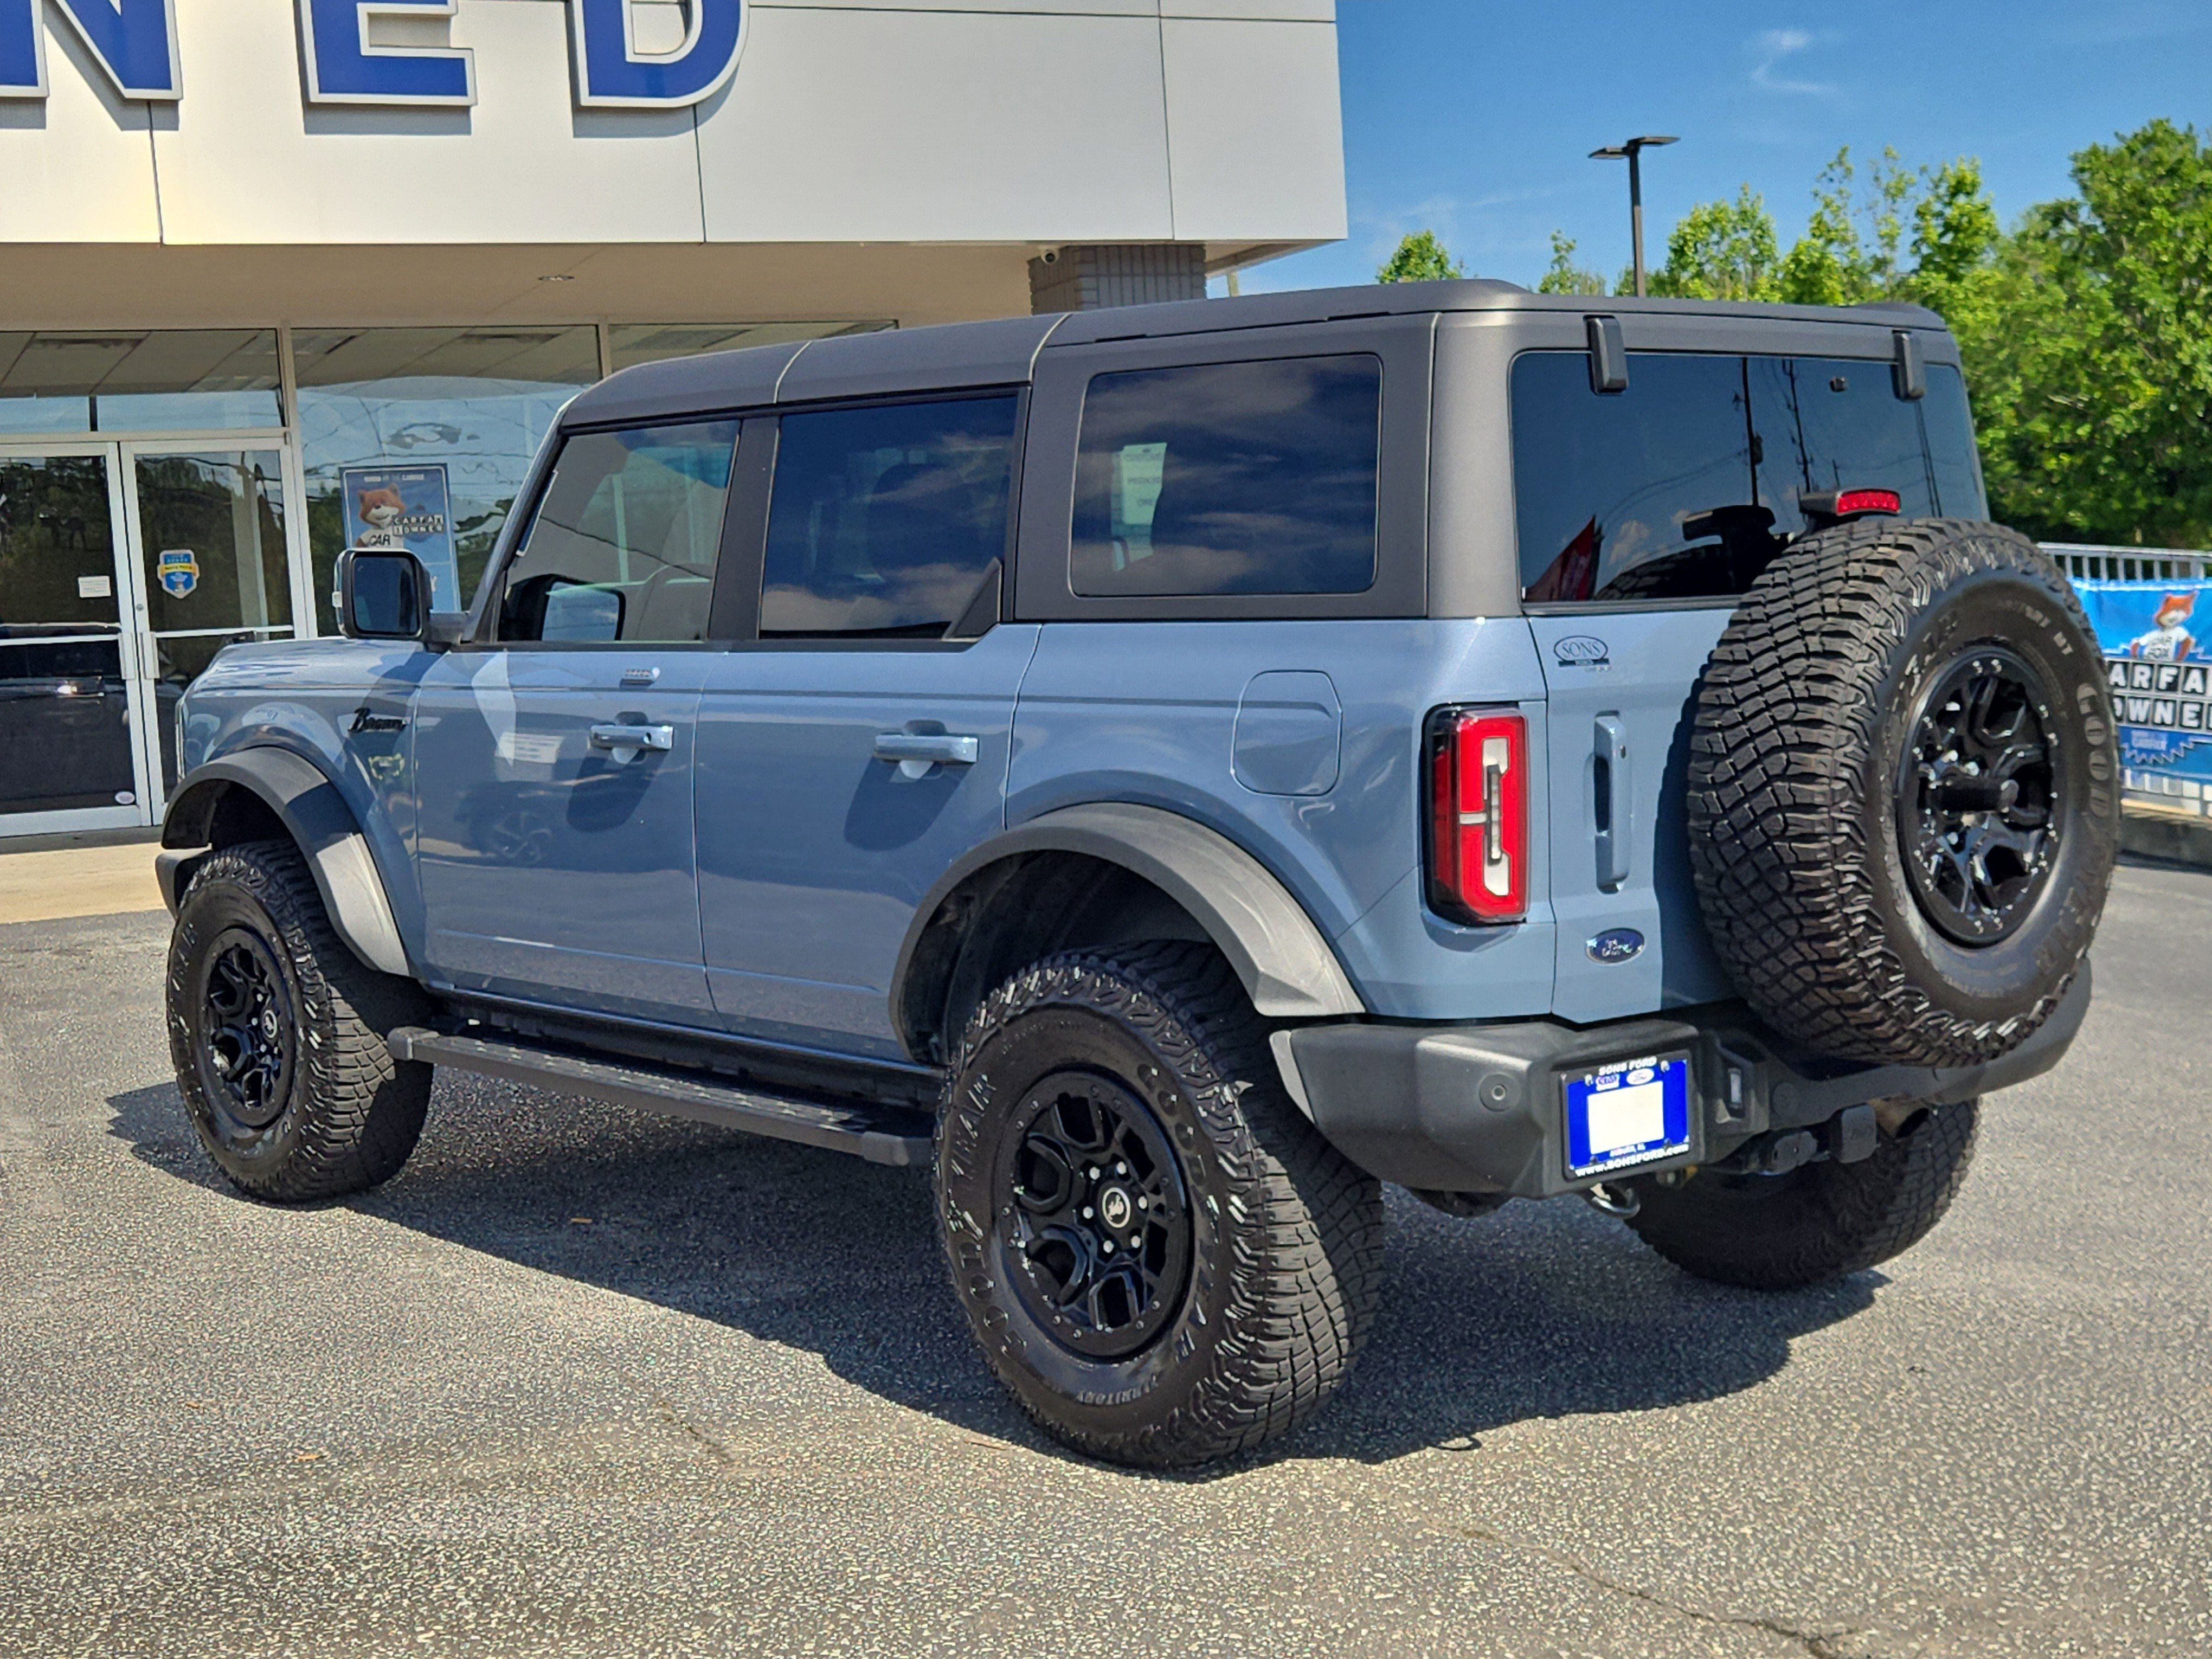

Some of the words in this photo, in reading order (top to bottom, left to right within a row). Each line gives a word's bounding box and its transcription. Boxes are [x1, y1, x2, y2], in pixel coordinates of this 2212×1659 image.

[394, 515, 443, 525] CARFAX
[370, 534, 390, 545] CAR
[2108, 663, 2204, 693] ARFA
[1598, 1064, 1627, 1076] SONS
[1629, 1056, 1657, 1070] FORD
